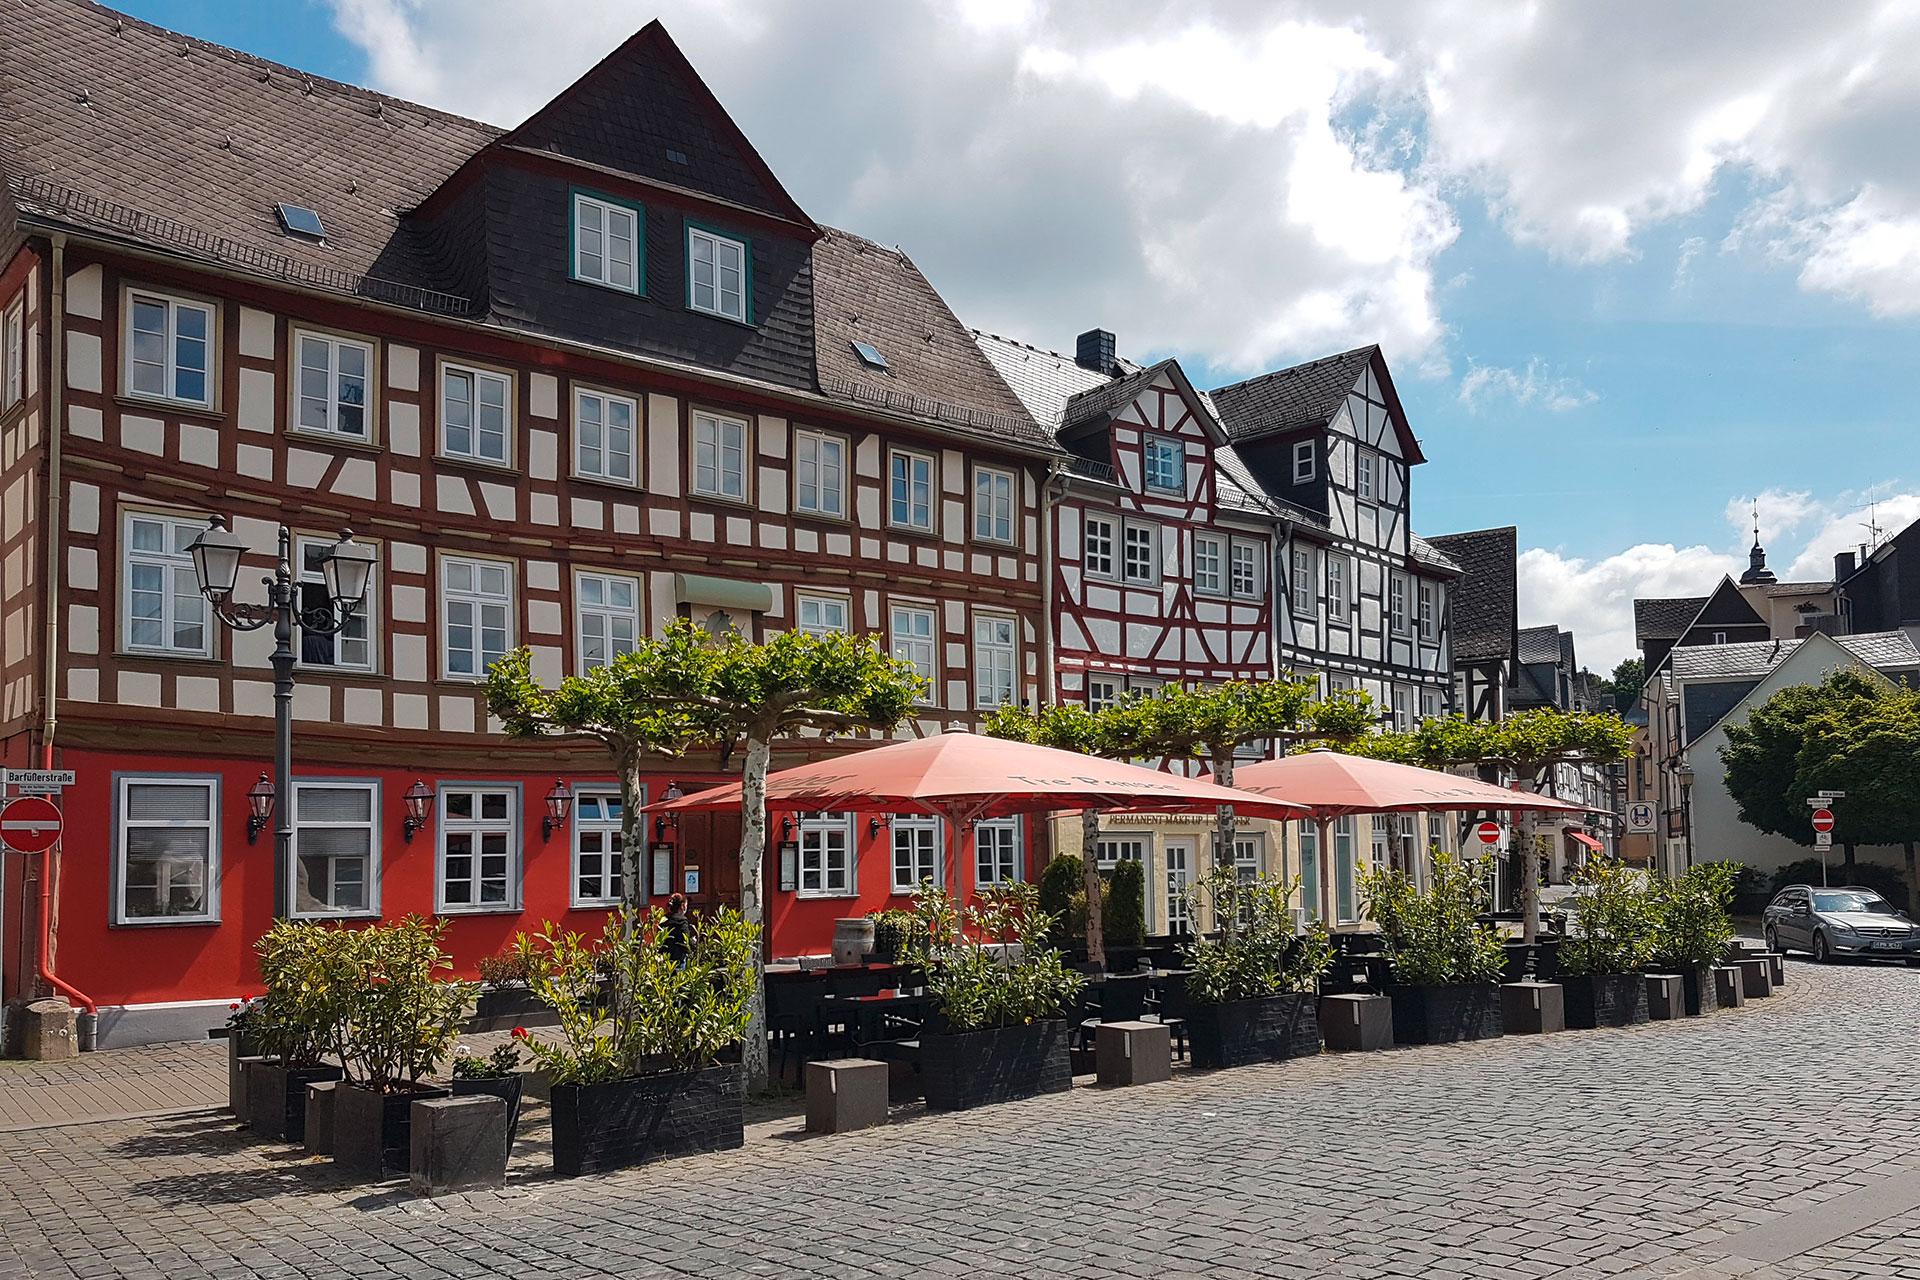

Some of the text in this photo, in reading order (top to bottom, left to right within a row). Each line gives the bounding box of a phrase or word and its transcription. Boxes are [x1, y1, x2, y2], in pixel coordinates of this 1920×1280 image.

[8, 772, 73, 782] Barfüßerstraße
[1007, 776, 1071, 786] Tre
[1109, 815, 1163, 825] PERMANENT
